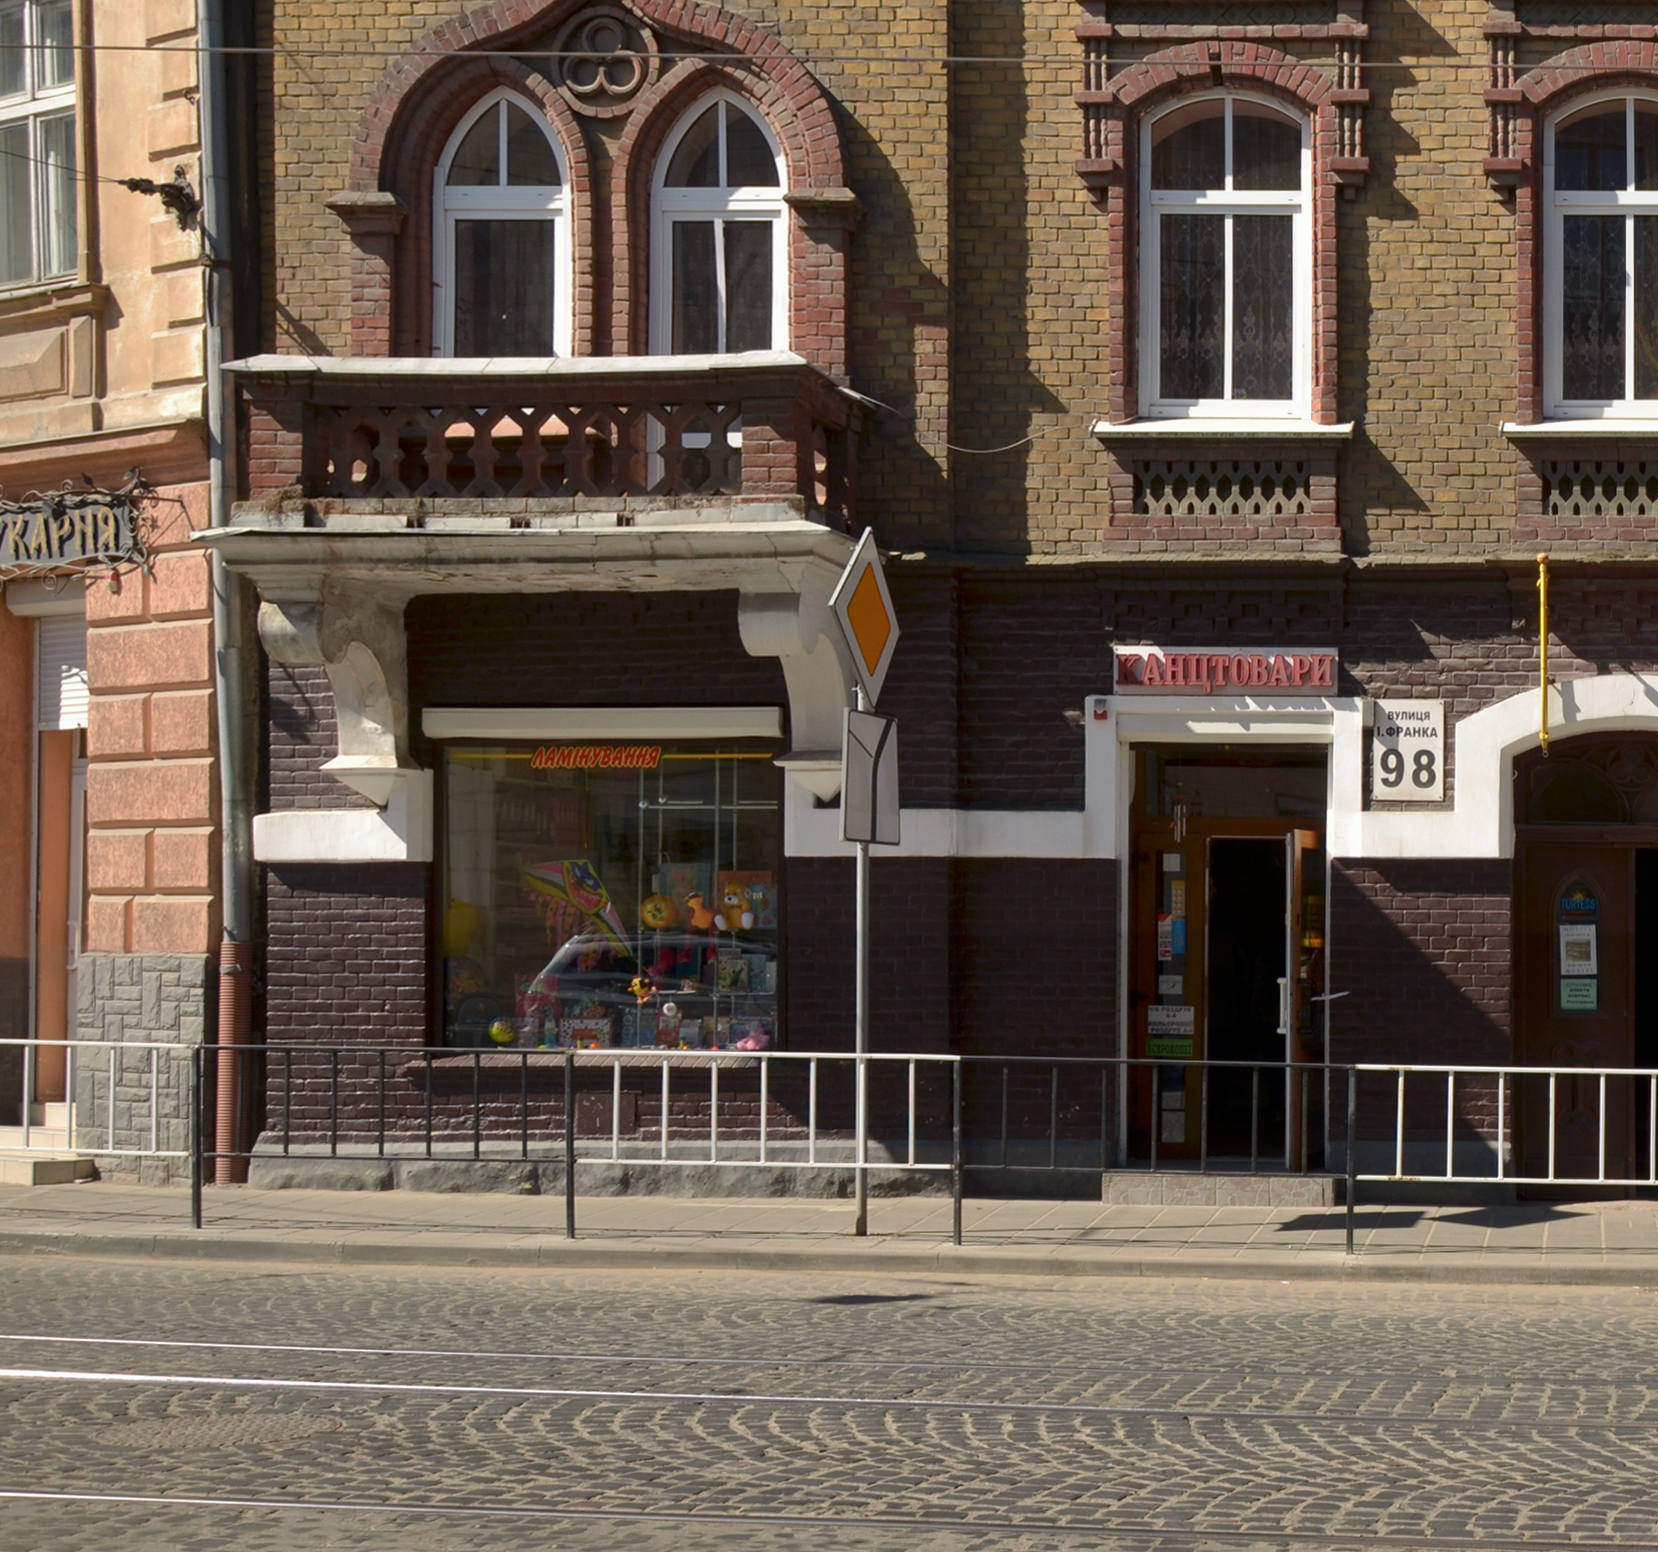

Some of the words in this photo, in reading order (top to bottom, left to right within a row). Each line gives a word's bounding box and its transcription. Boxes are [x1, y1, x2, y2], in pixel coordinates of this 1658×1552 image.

[0, 506, 117, 556] КАРНЯ
[1115, 652, 1335, 694] КАНЦТОВАРИ
[1387, 710, 1431, 723] ВУЛИЦЯ
[1376, 724, 1439, 739] І.ФРАНКА
[531, 746, 661, 769] ЛАМІНУВАННЯ
[1379, 748, 1437, 789] 98
[1561, 898, 1596, 910] TURTESS
